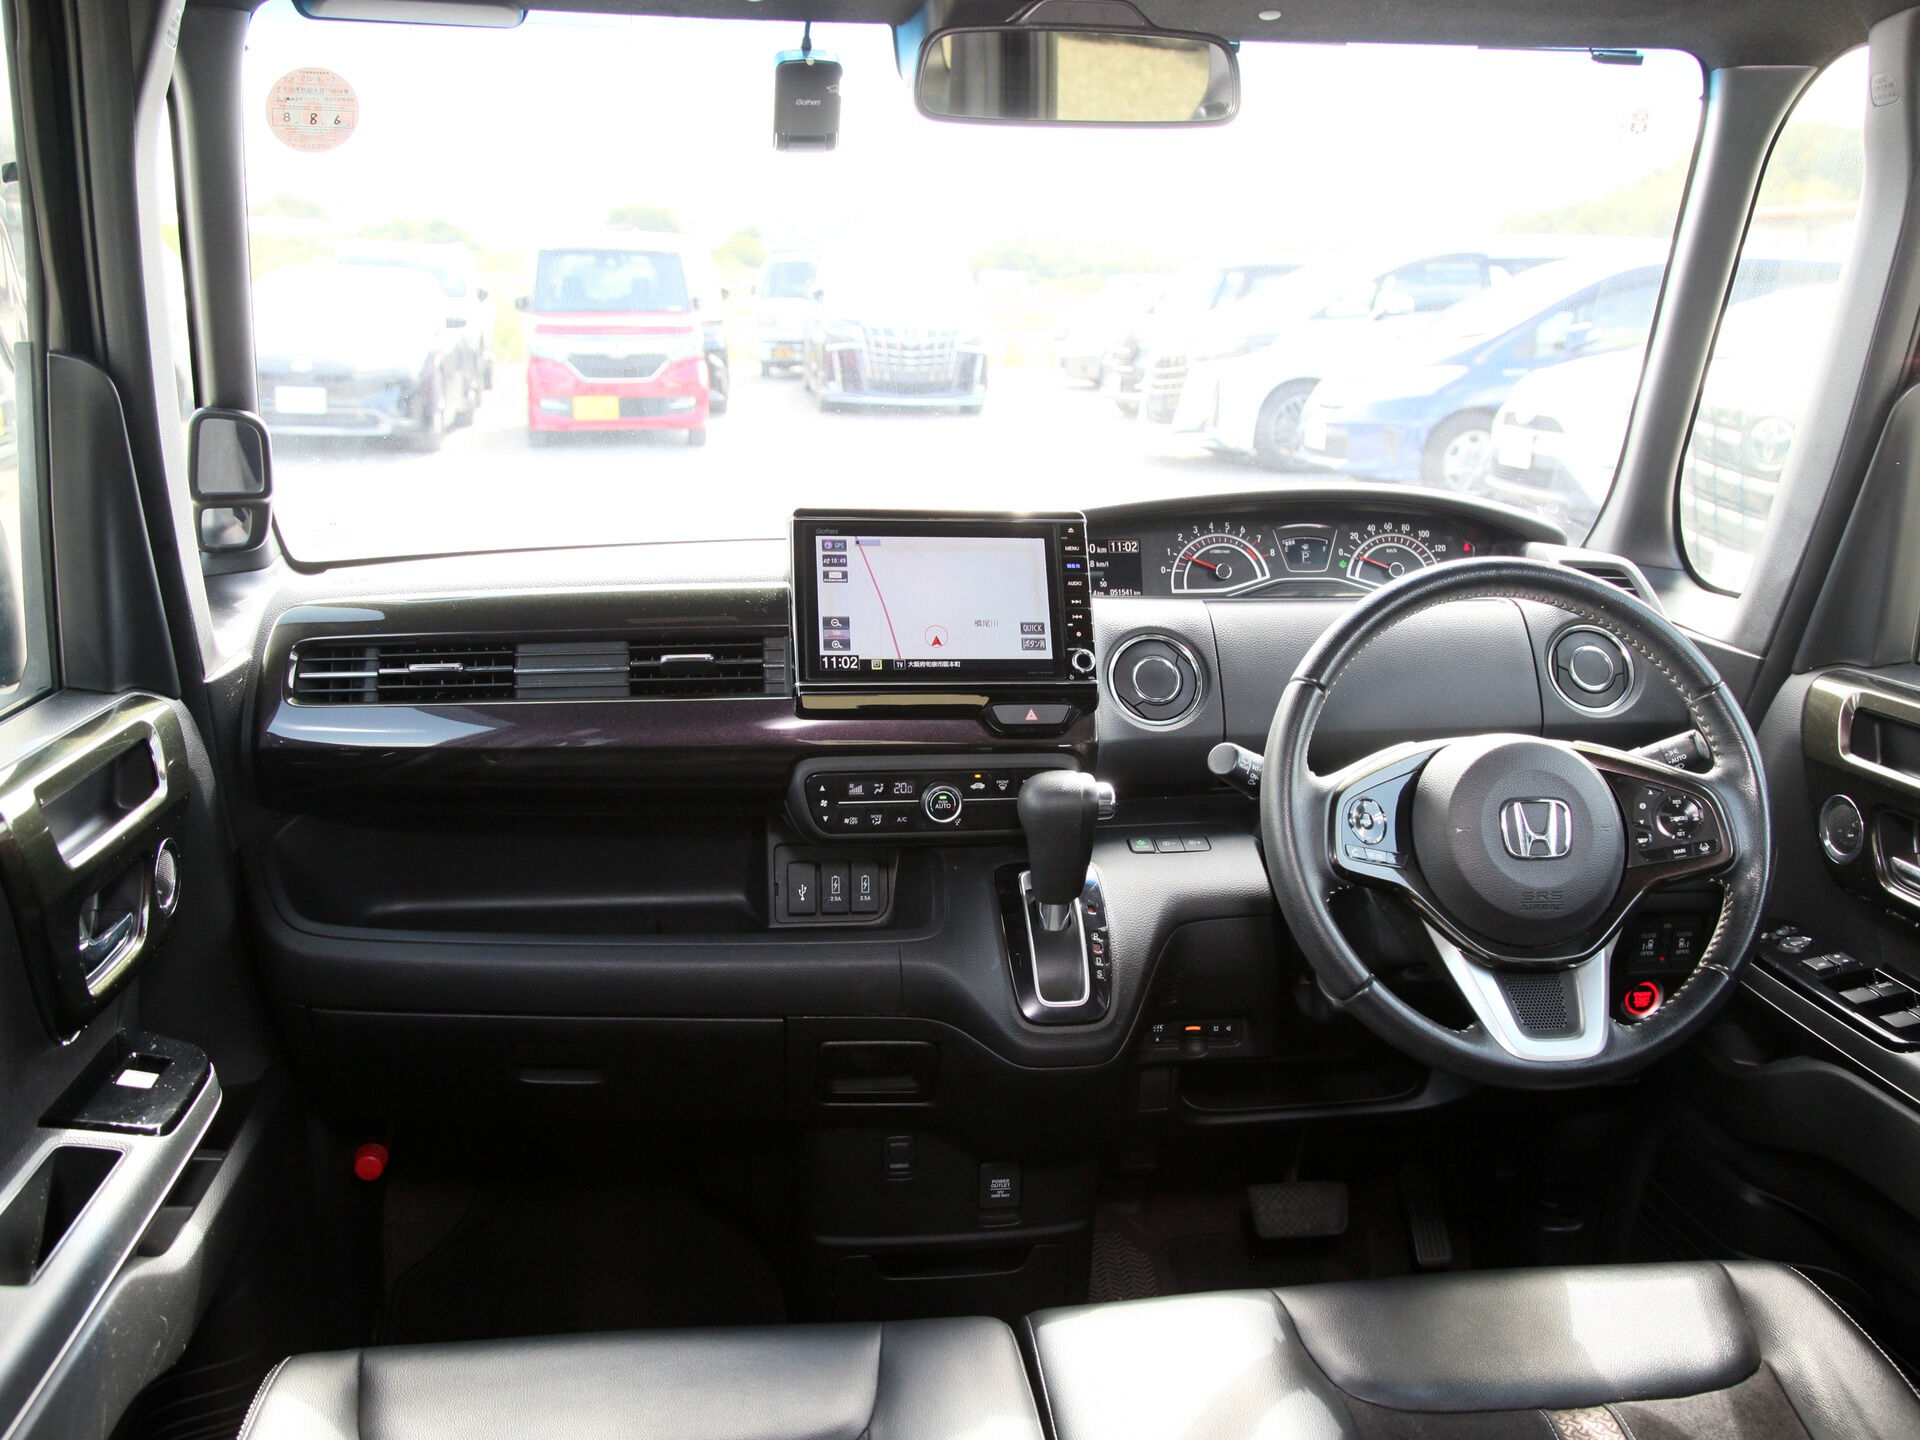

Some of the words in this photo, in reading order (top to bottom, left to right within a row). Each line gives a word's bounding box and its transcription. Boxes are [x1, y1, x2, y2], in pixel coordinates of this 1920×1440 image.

[283, 112, 290, 122] 8
[310, 112, 317, 125] 8
[334, 115, 341, 125] 6
[1111, 541, 1138, 552] 11:02
[1435, 544, 1446, 552] 120
[1023, 624, 1042, 632] QUICK
[822, 656, 858, 669] 11:02
[1671, 754, 1687, 764] AUTO
[1521, 890, 1563, 900] SRS
